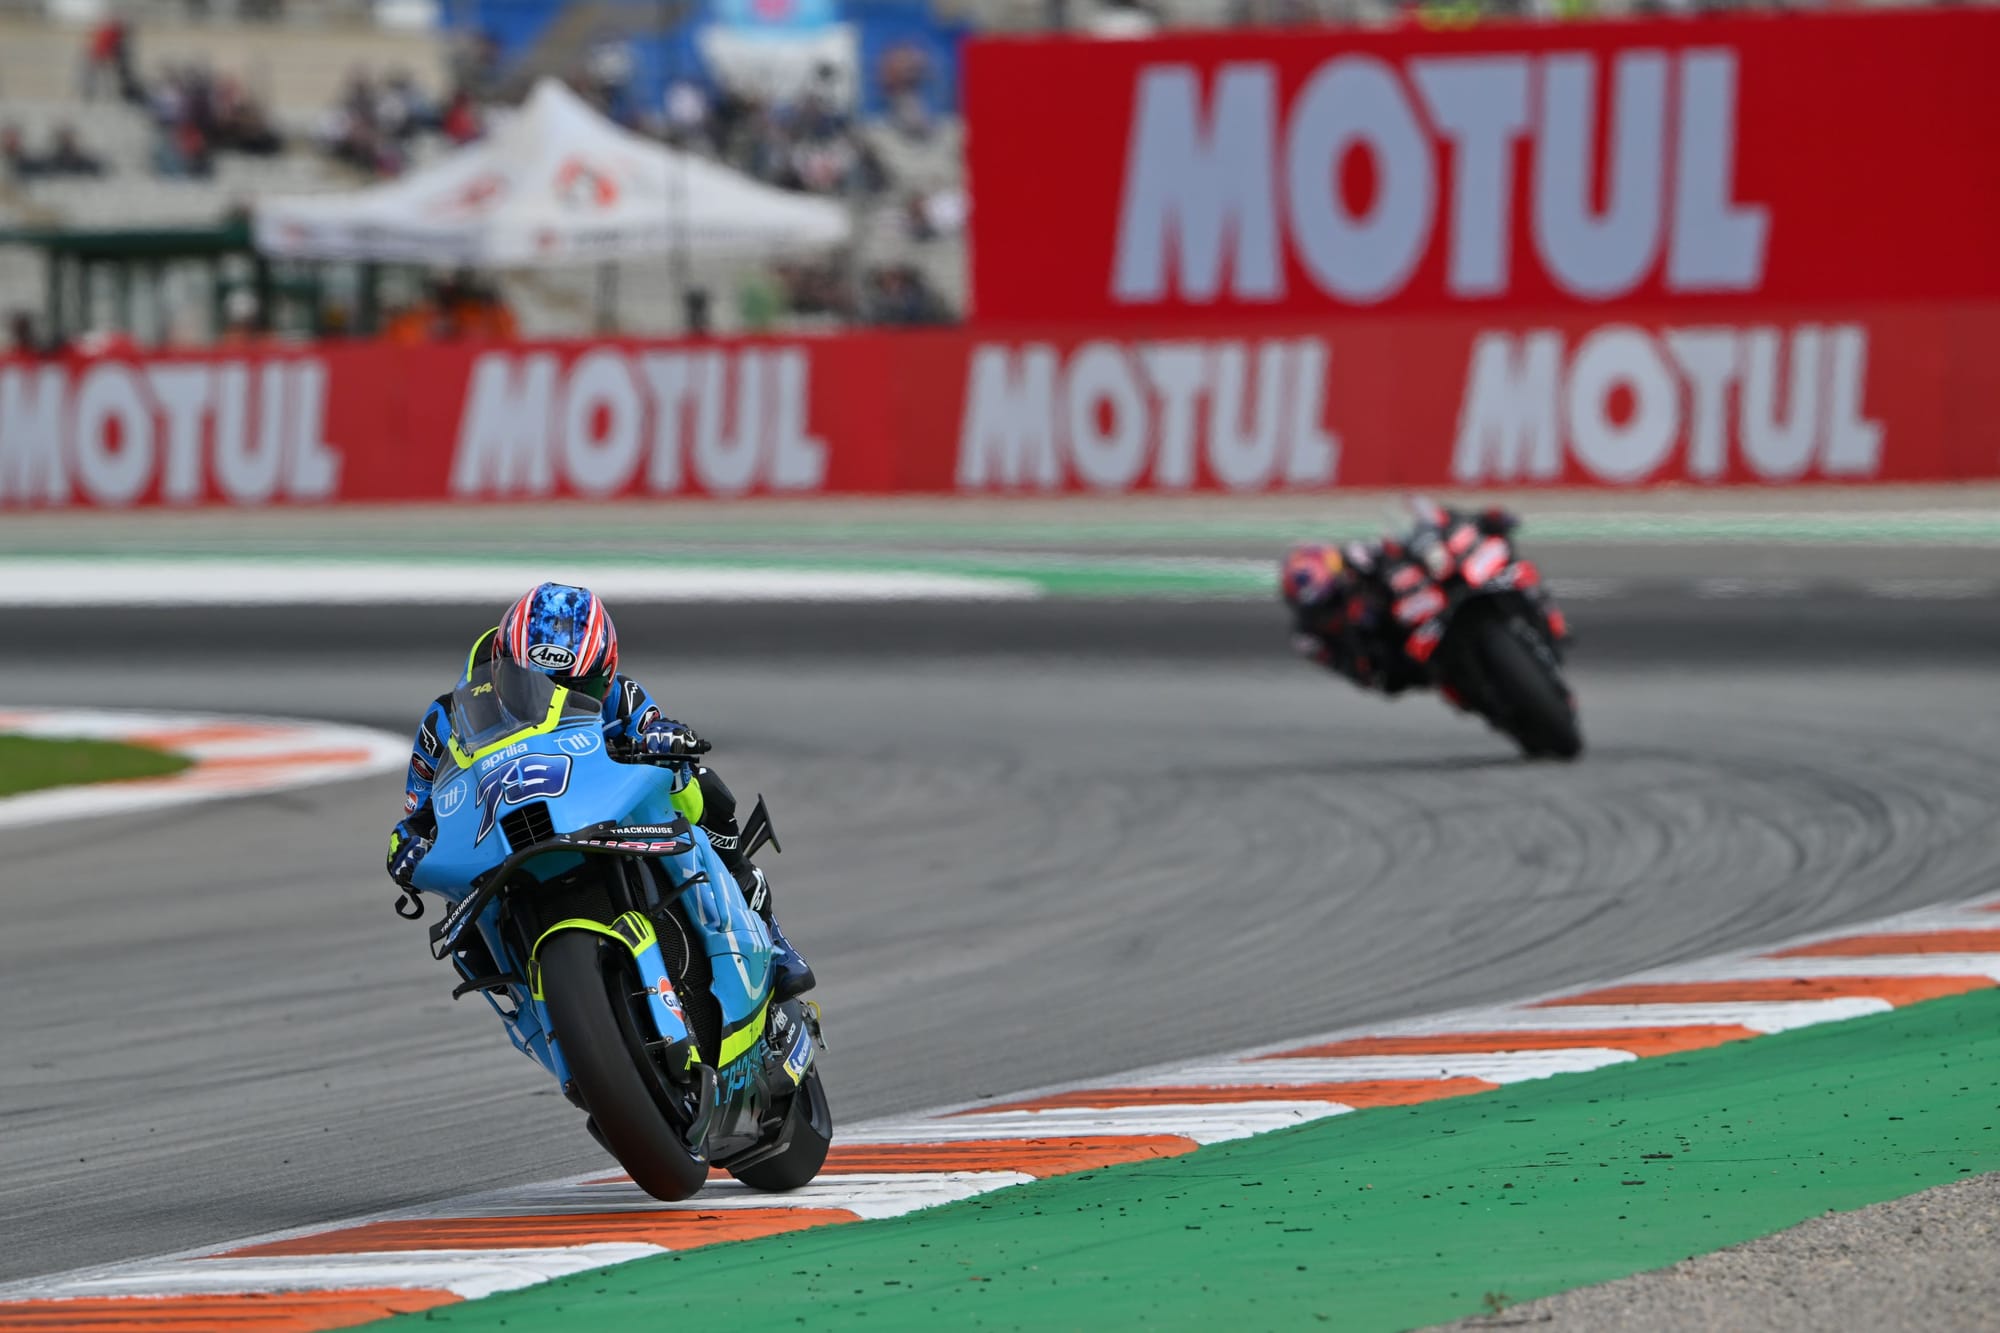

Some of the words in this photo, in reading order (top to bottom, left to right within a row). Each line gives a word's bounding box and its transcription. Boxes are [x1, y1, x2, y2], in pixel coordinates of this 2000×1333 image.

[1112, 46, 1770, 302] MOTUL
[0, 358, 341, 504] MOTUL
[450, 346, 828, 494] MOTUL
[955, 336, 1341, 490] MOTUL
[1451, 324, 1884, 482] MOTUL
[530, 647, 571, 664] Arai
[481, 742, 529, 771] aprilia
[609, 826, 674, 835] TRACKHOUSE
